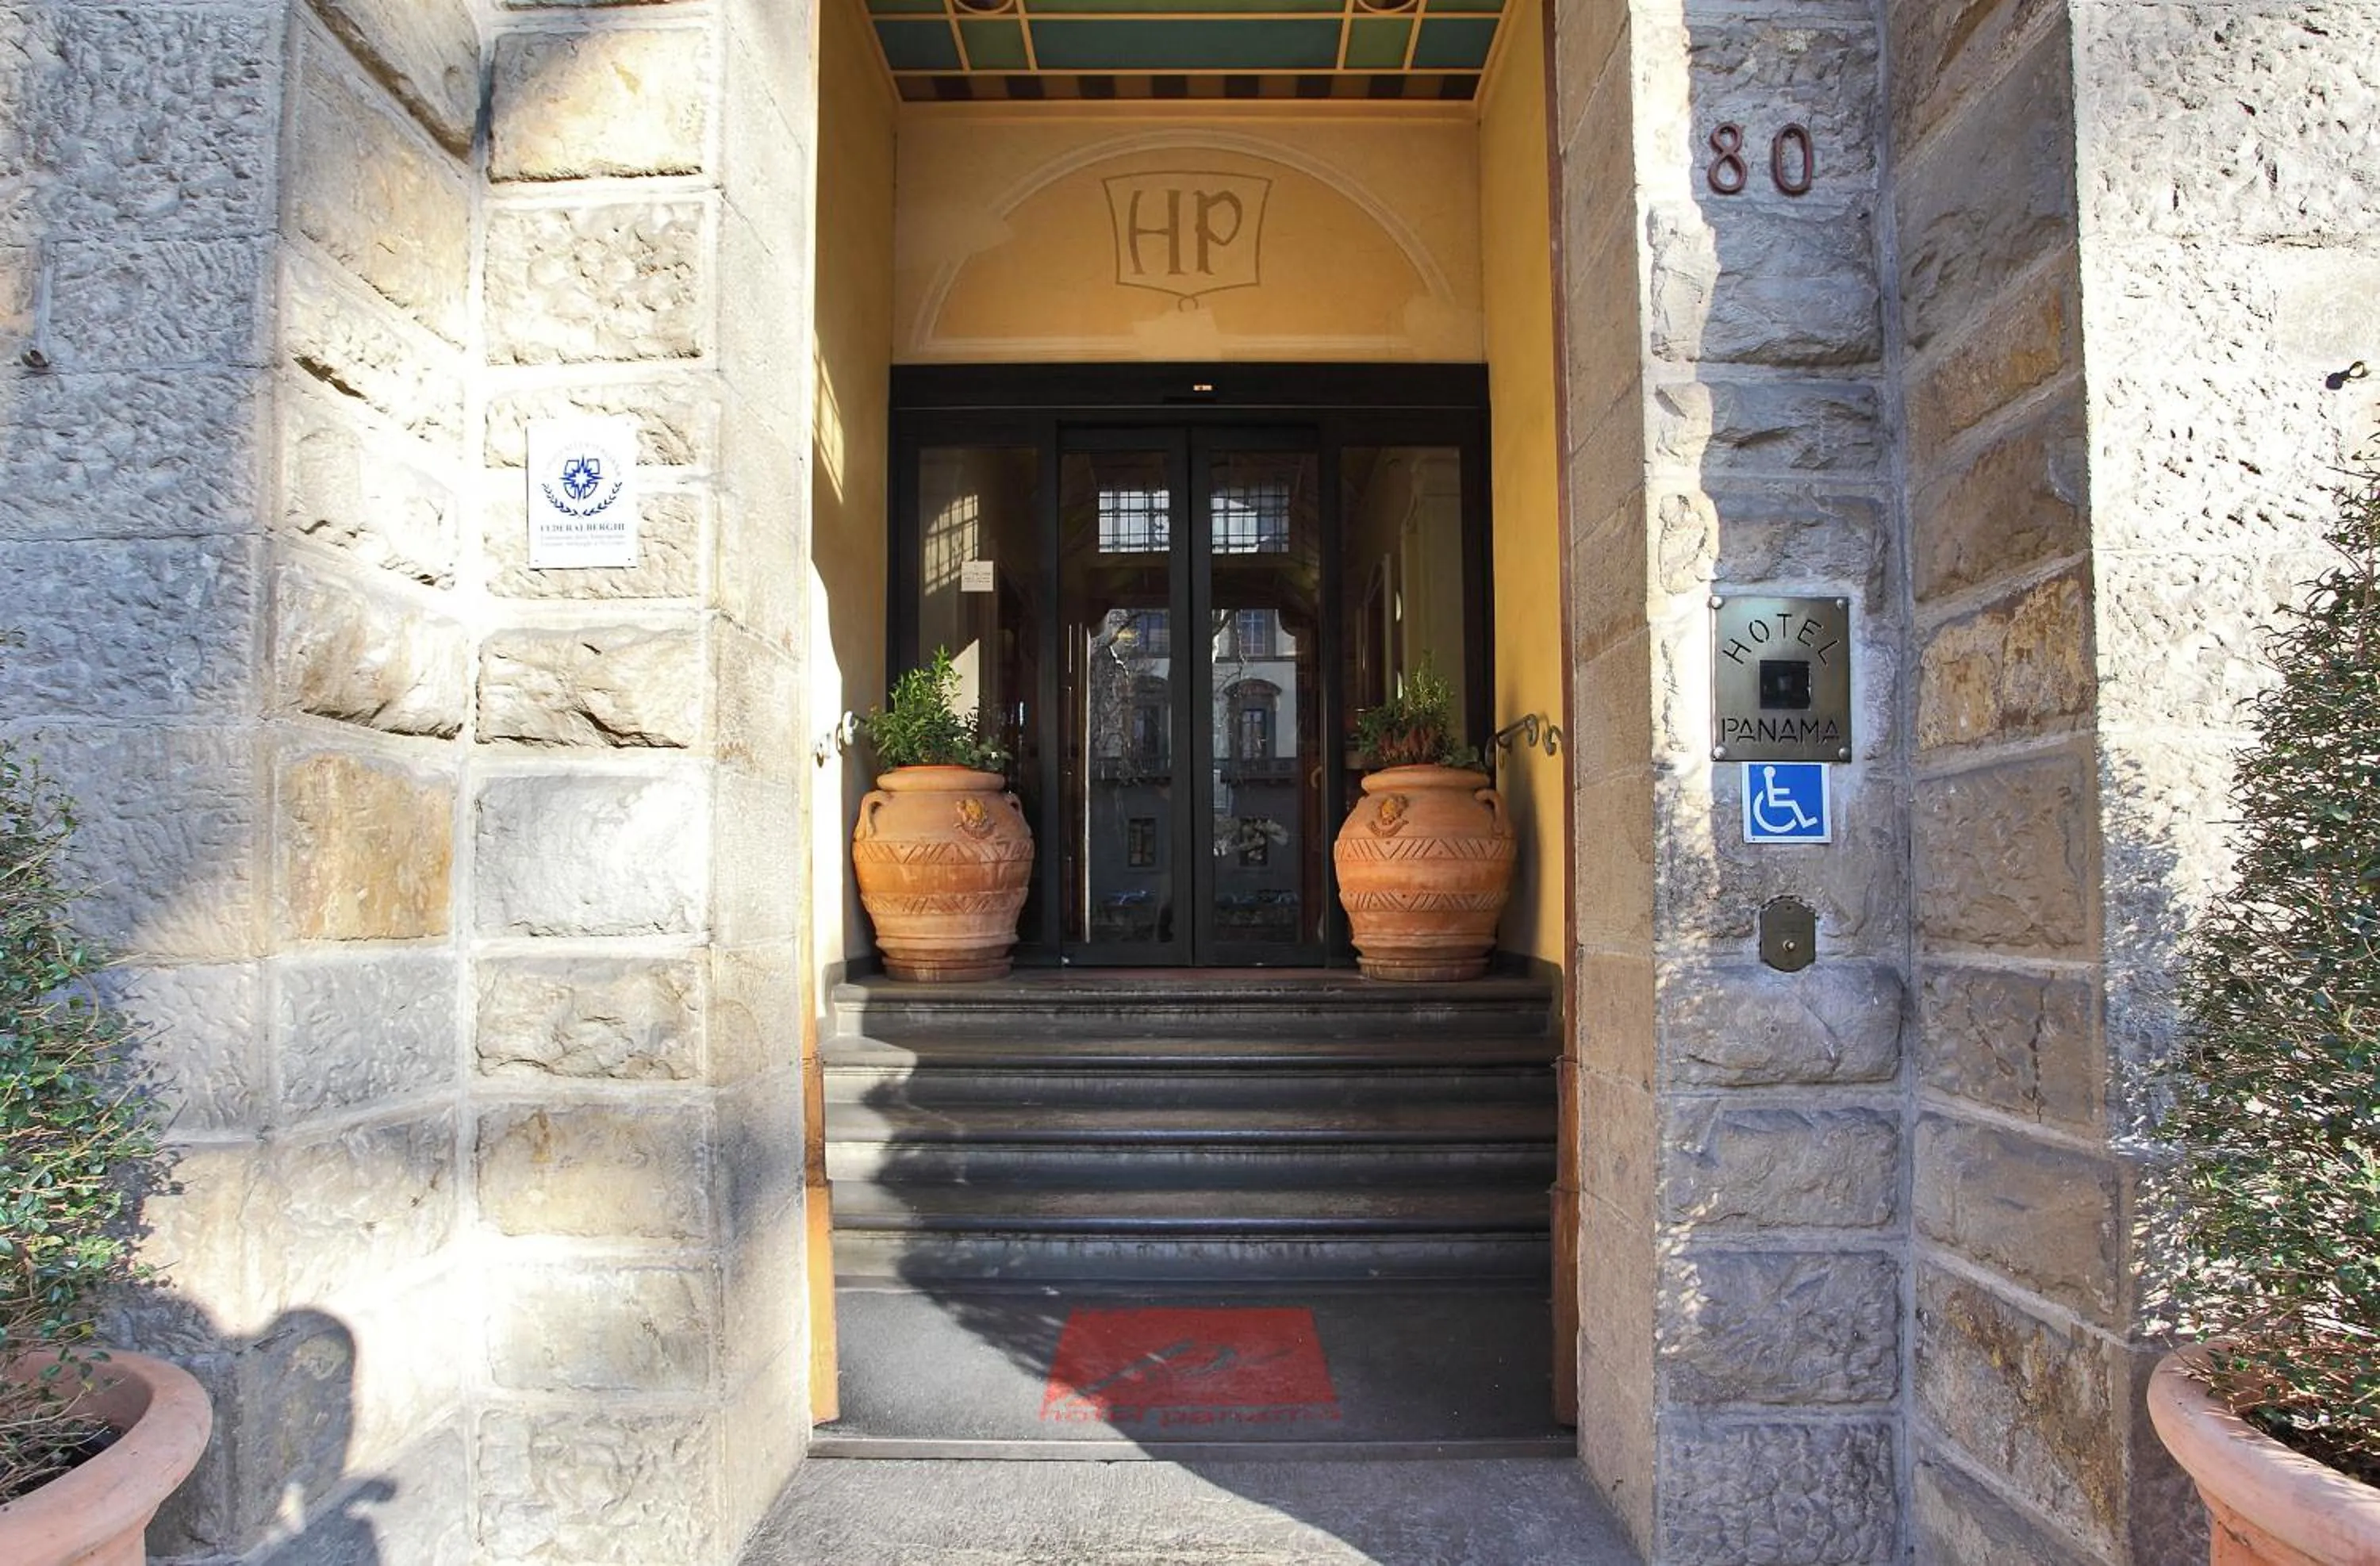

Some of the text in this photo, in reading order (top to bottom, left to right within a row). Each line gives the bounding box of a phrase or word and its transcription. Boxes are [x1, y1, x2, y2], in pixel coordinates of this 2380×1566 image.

[1707, 122, 1813, 196] 80
[1128, 190, 1243, 275] HP
[1722, 613, 1840, 666] HOTEL
[1722, 718, 1840, 743] PANAMA
